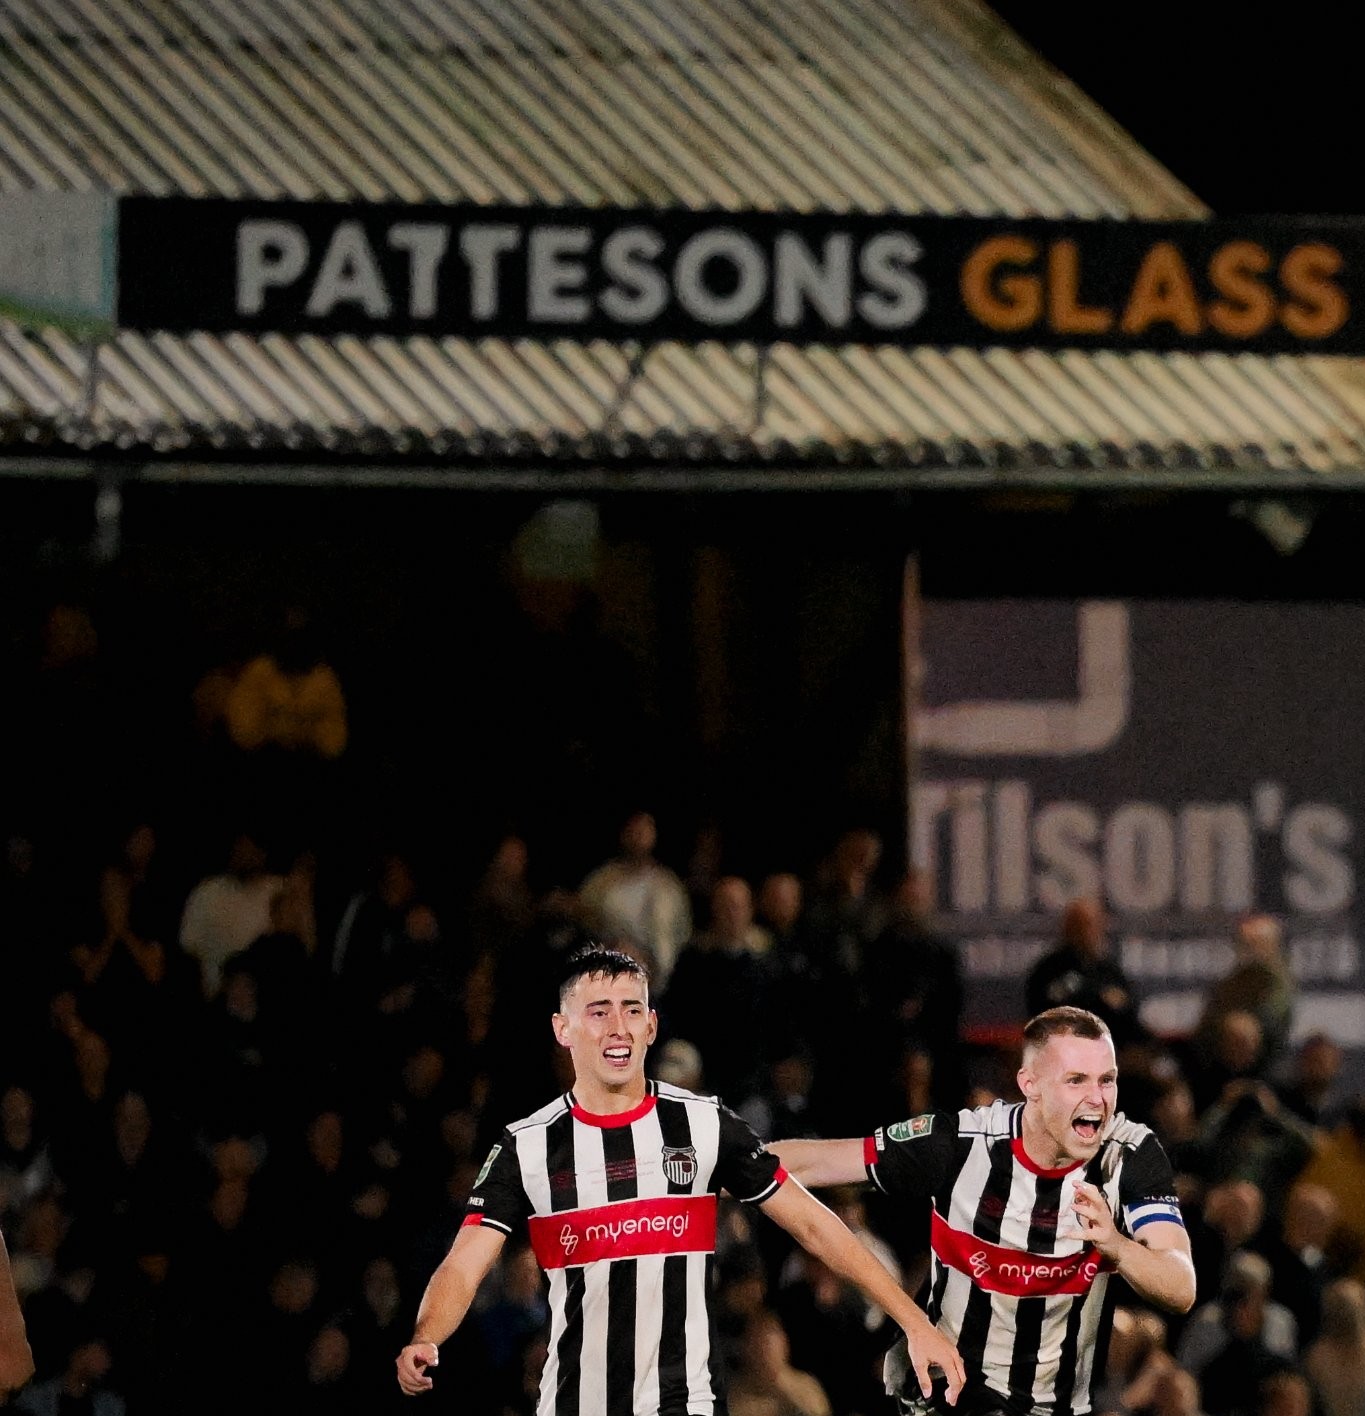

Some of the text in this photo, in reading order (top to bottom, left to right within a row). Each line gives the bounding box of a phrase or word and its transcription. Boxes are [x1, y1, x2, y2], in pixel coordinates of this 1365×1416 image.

[236, 221, 1351, 339] PATTESONS GLASS
[585, 1211, 690, 1243] myenergi
